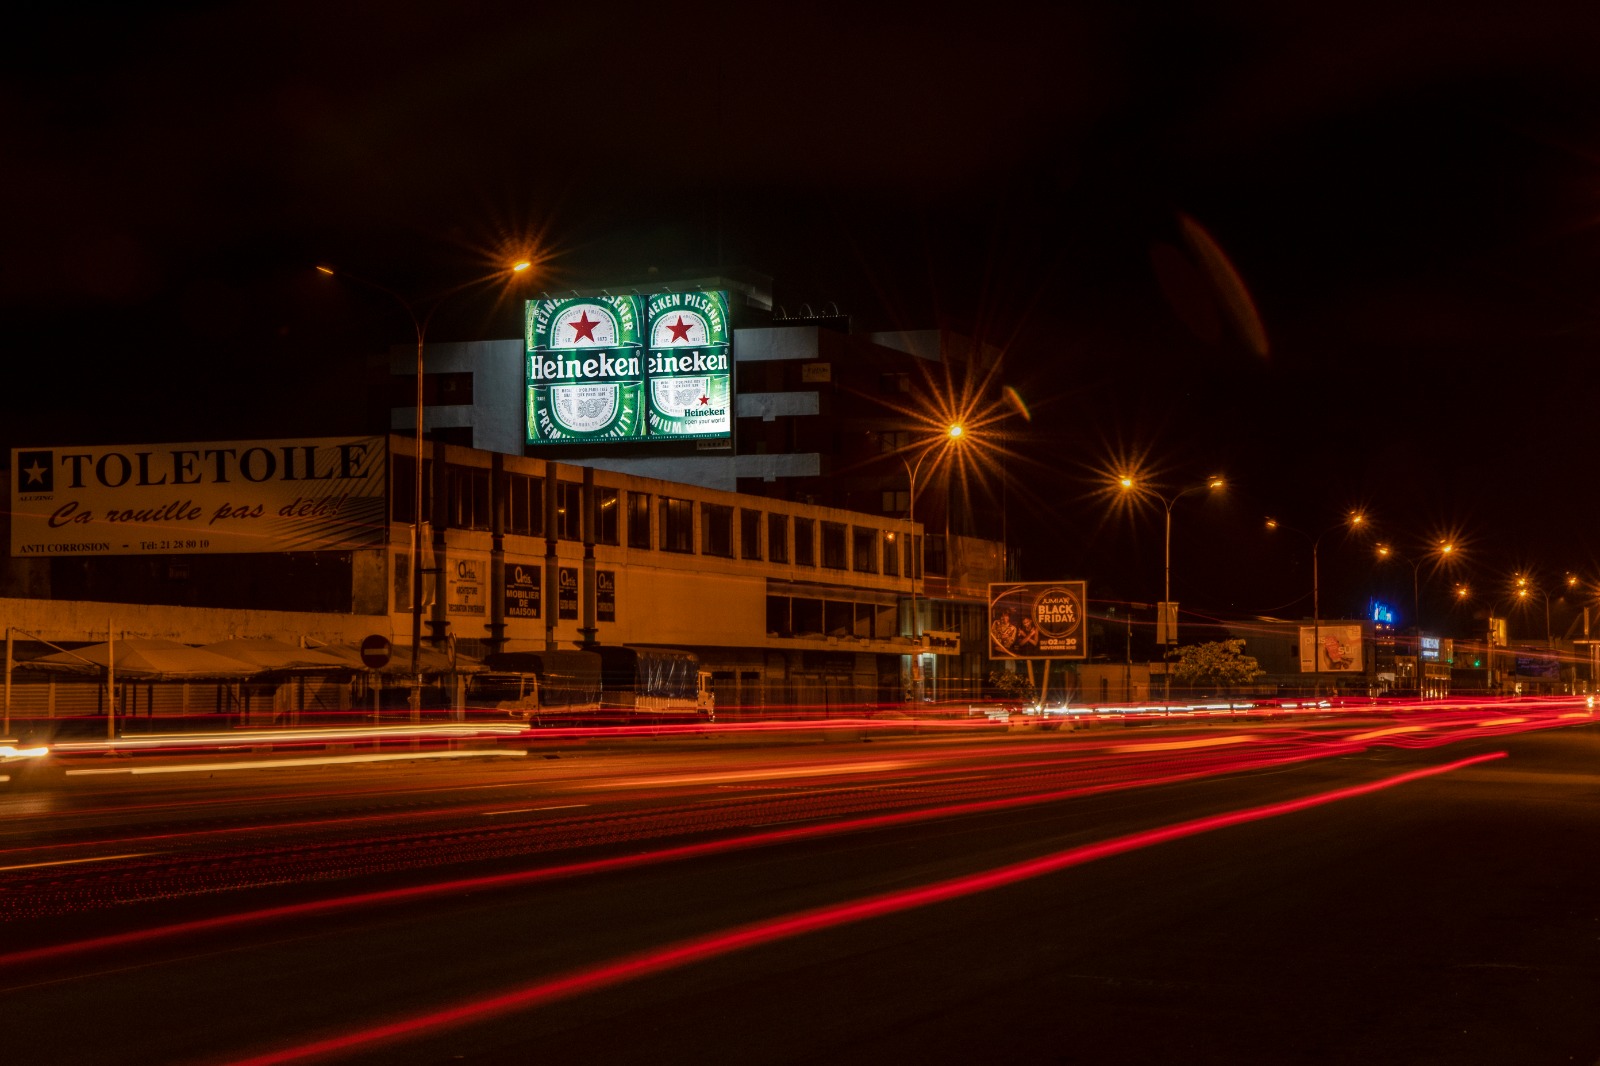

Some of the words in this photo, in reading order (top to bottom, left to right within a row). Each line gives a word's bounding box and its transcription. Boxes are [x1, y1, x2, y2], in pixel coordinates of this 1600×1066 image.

[684, 293, 722, 334] PILSENER
[530, 353, 640, 380] Heineken
[684, 407, 725, 417] Heineken
[61, 445, 370, 488] TOLETOILE
[107, 500, 202, 522] rouille
[208, 502, 265, 525] pas
[20, 544, 45, 553] ANTI
[47, 542, 110, 552] CORROSION
[160, 540, 171, 549] 21
[173, 540, 184, 549] 28
[185, 540, 197, 549] 80
[199, 539, 210, 548] 10
[506, 589, 540, 600] MOBILIER
[518, 599, 529, 608] DE
[1038, 604, 1074, 614] BLACK
[509, 607, 537, 617] MAISON
